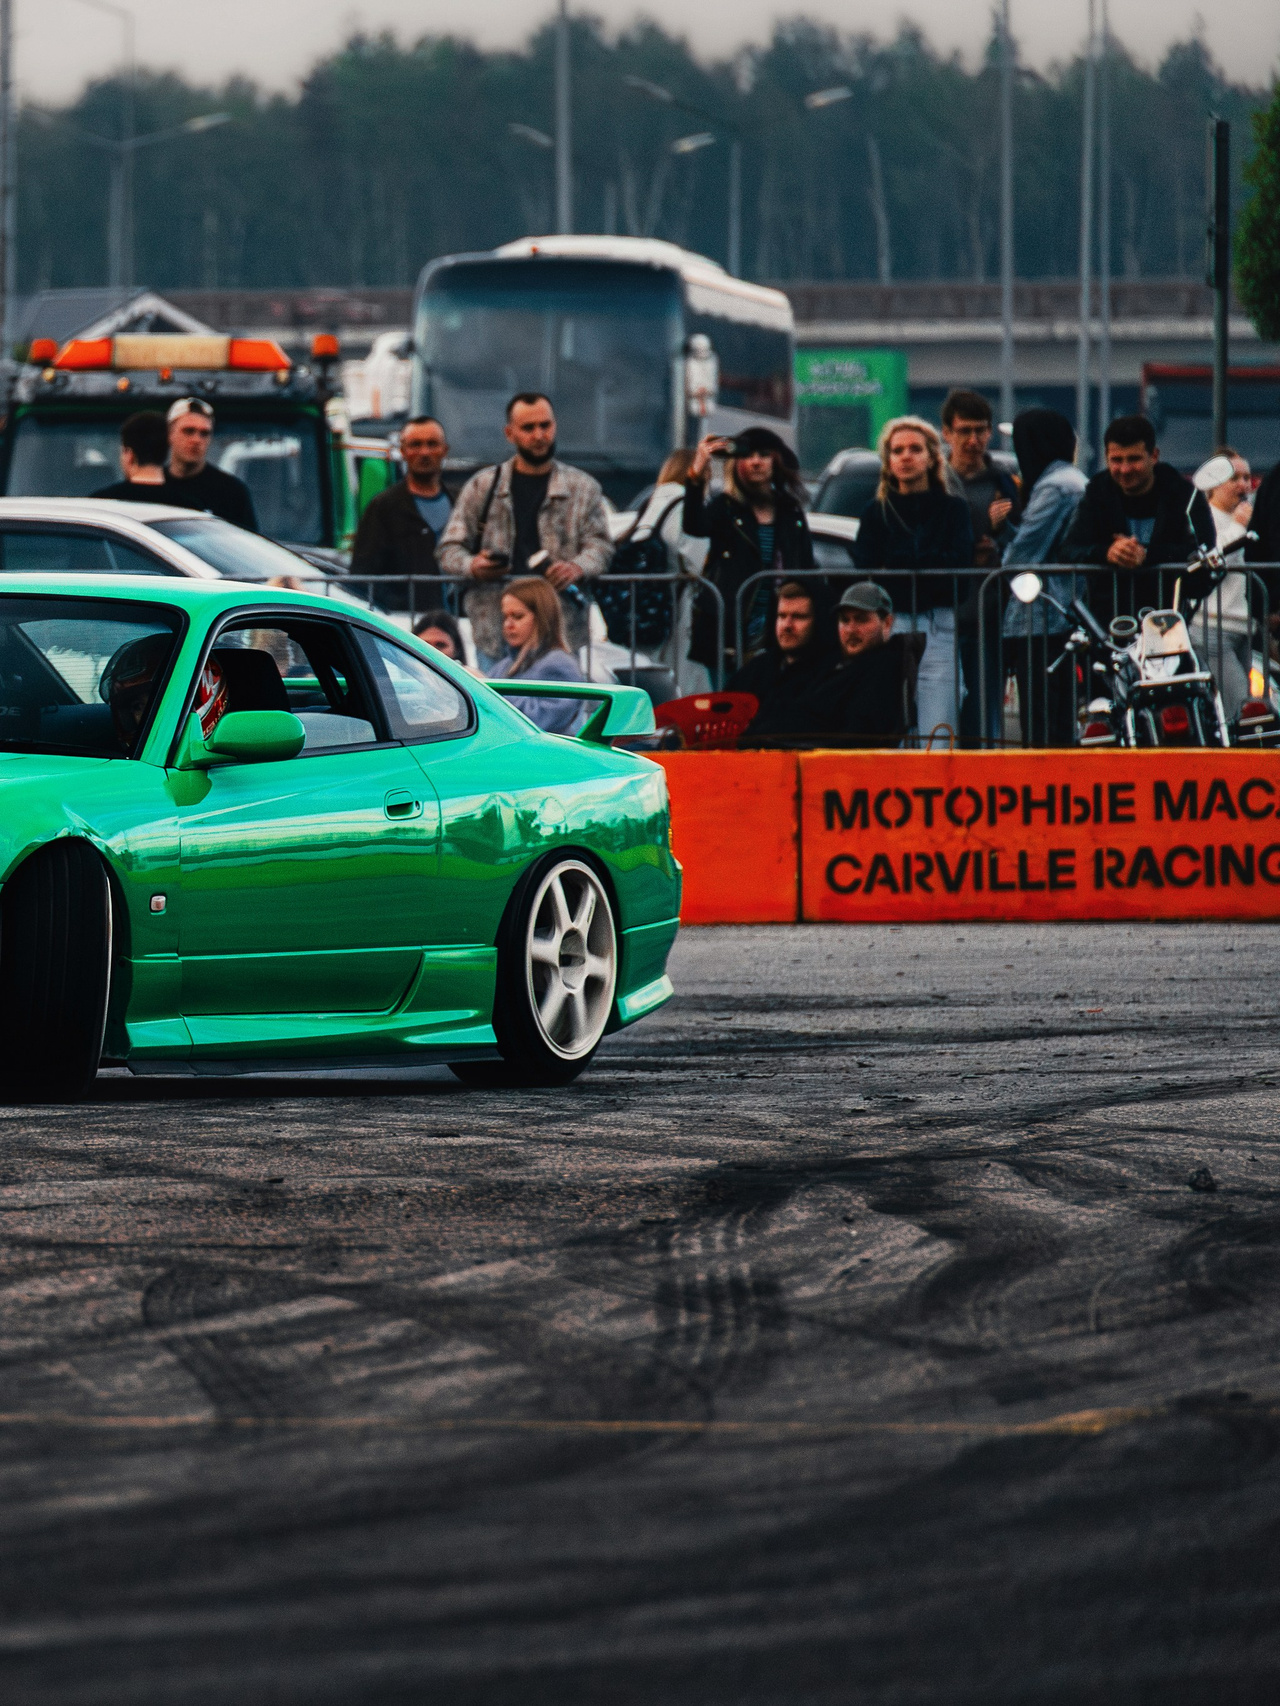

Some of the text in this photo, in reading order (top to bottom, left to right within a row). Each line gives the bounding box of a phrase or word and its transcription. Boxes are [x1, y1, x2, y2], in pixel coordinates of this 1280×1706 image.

[823, 778, 1280, 830] МОТОРНЫЕ МАС
[825, 850, 1077, 894] CARVILLE
